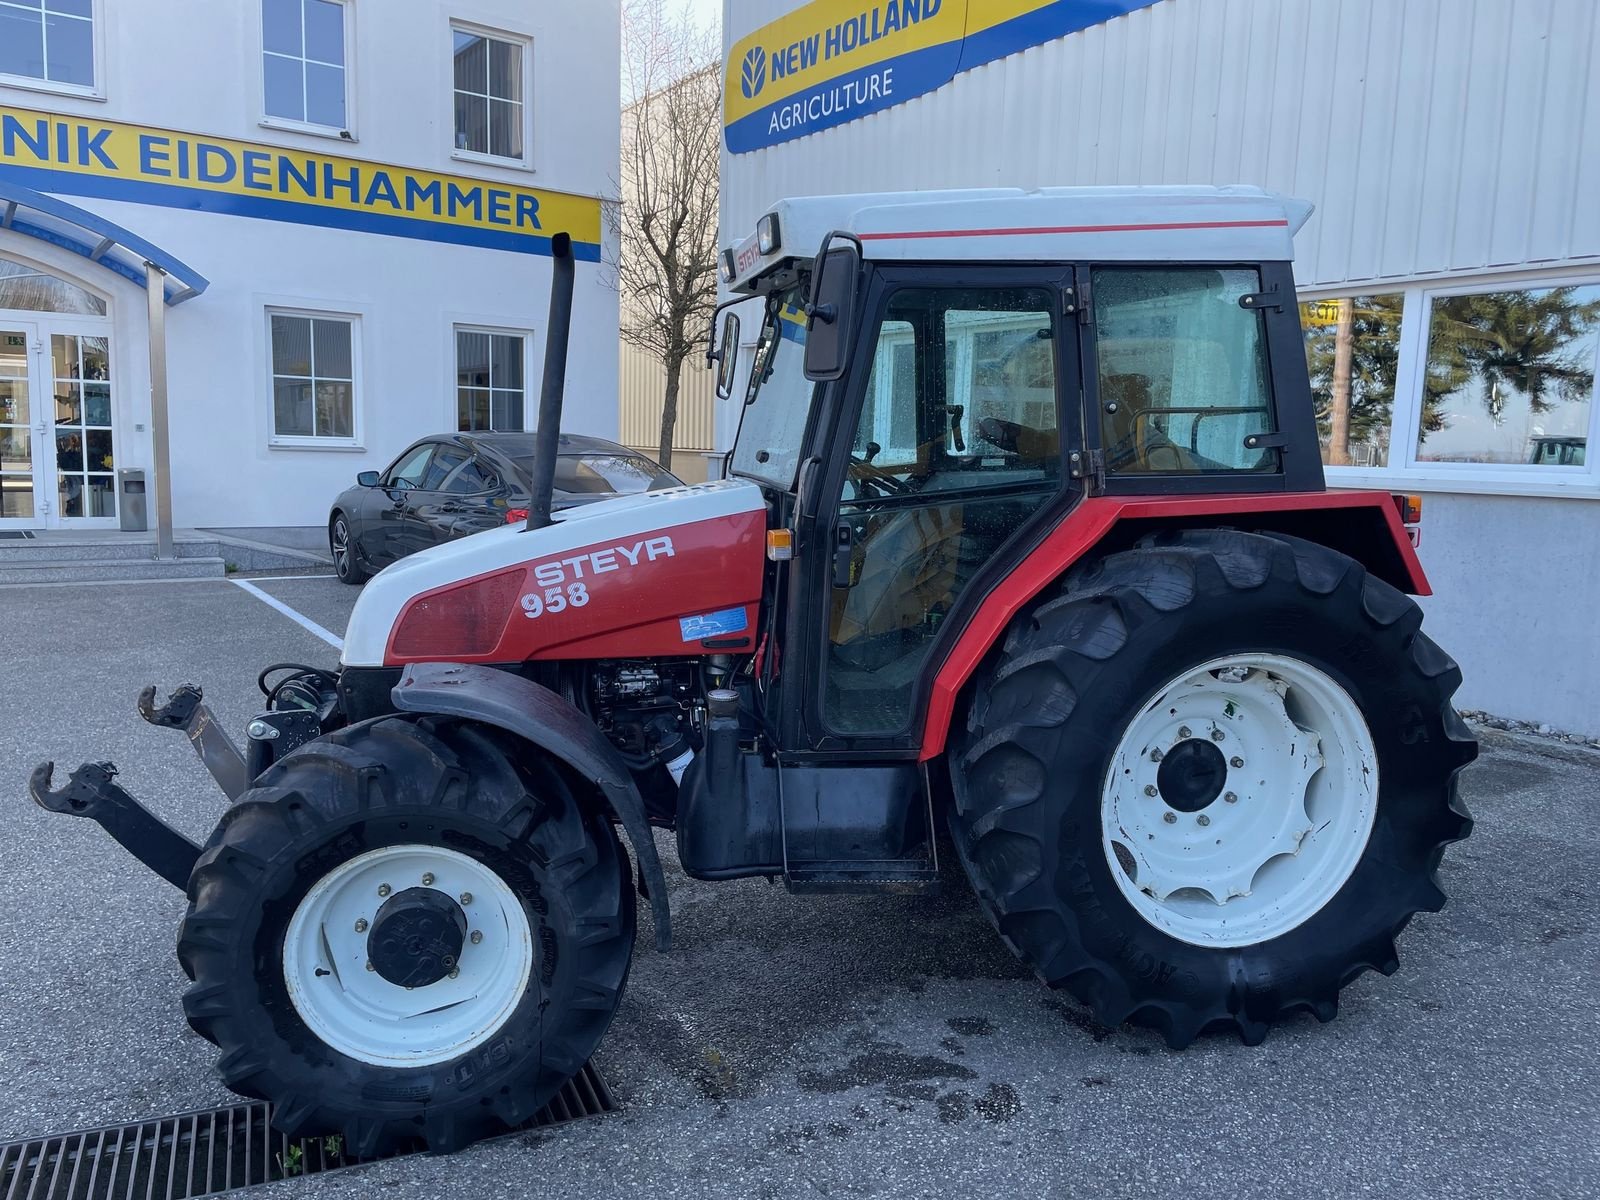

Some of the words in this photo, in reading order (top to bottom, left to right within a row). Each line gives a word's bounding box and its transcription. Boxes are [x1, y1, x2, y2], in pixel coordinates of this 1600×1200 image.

[771, 33, 820, 82] NEW
[825, 0, 942, 60] HOLLAND
[768, 68, 893, 135] AGRICULTURE
[2, 114, 118, 171] NIK
[139, 134, 542, 229] EIDENHAMMER
[534, 535, 676, 587] STEYR
[520, 582, 590, 619] 958
